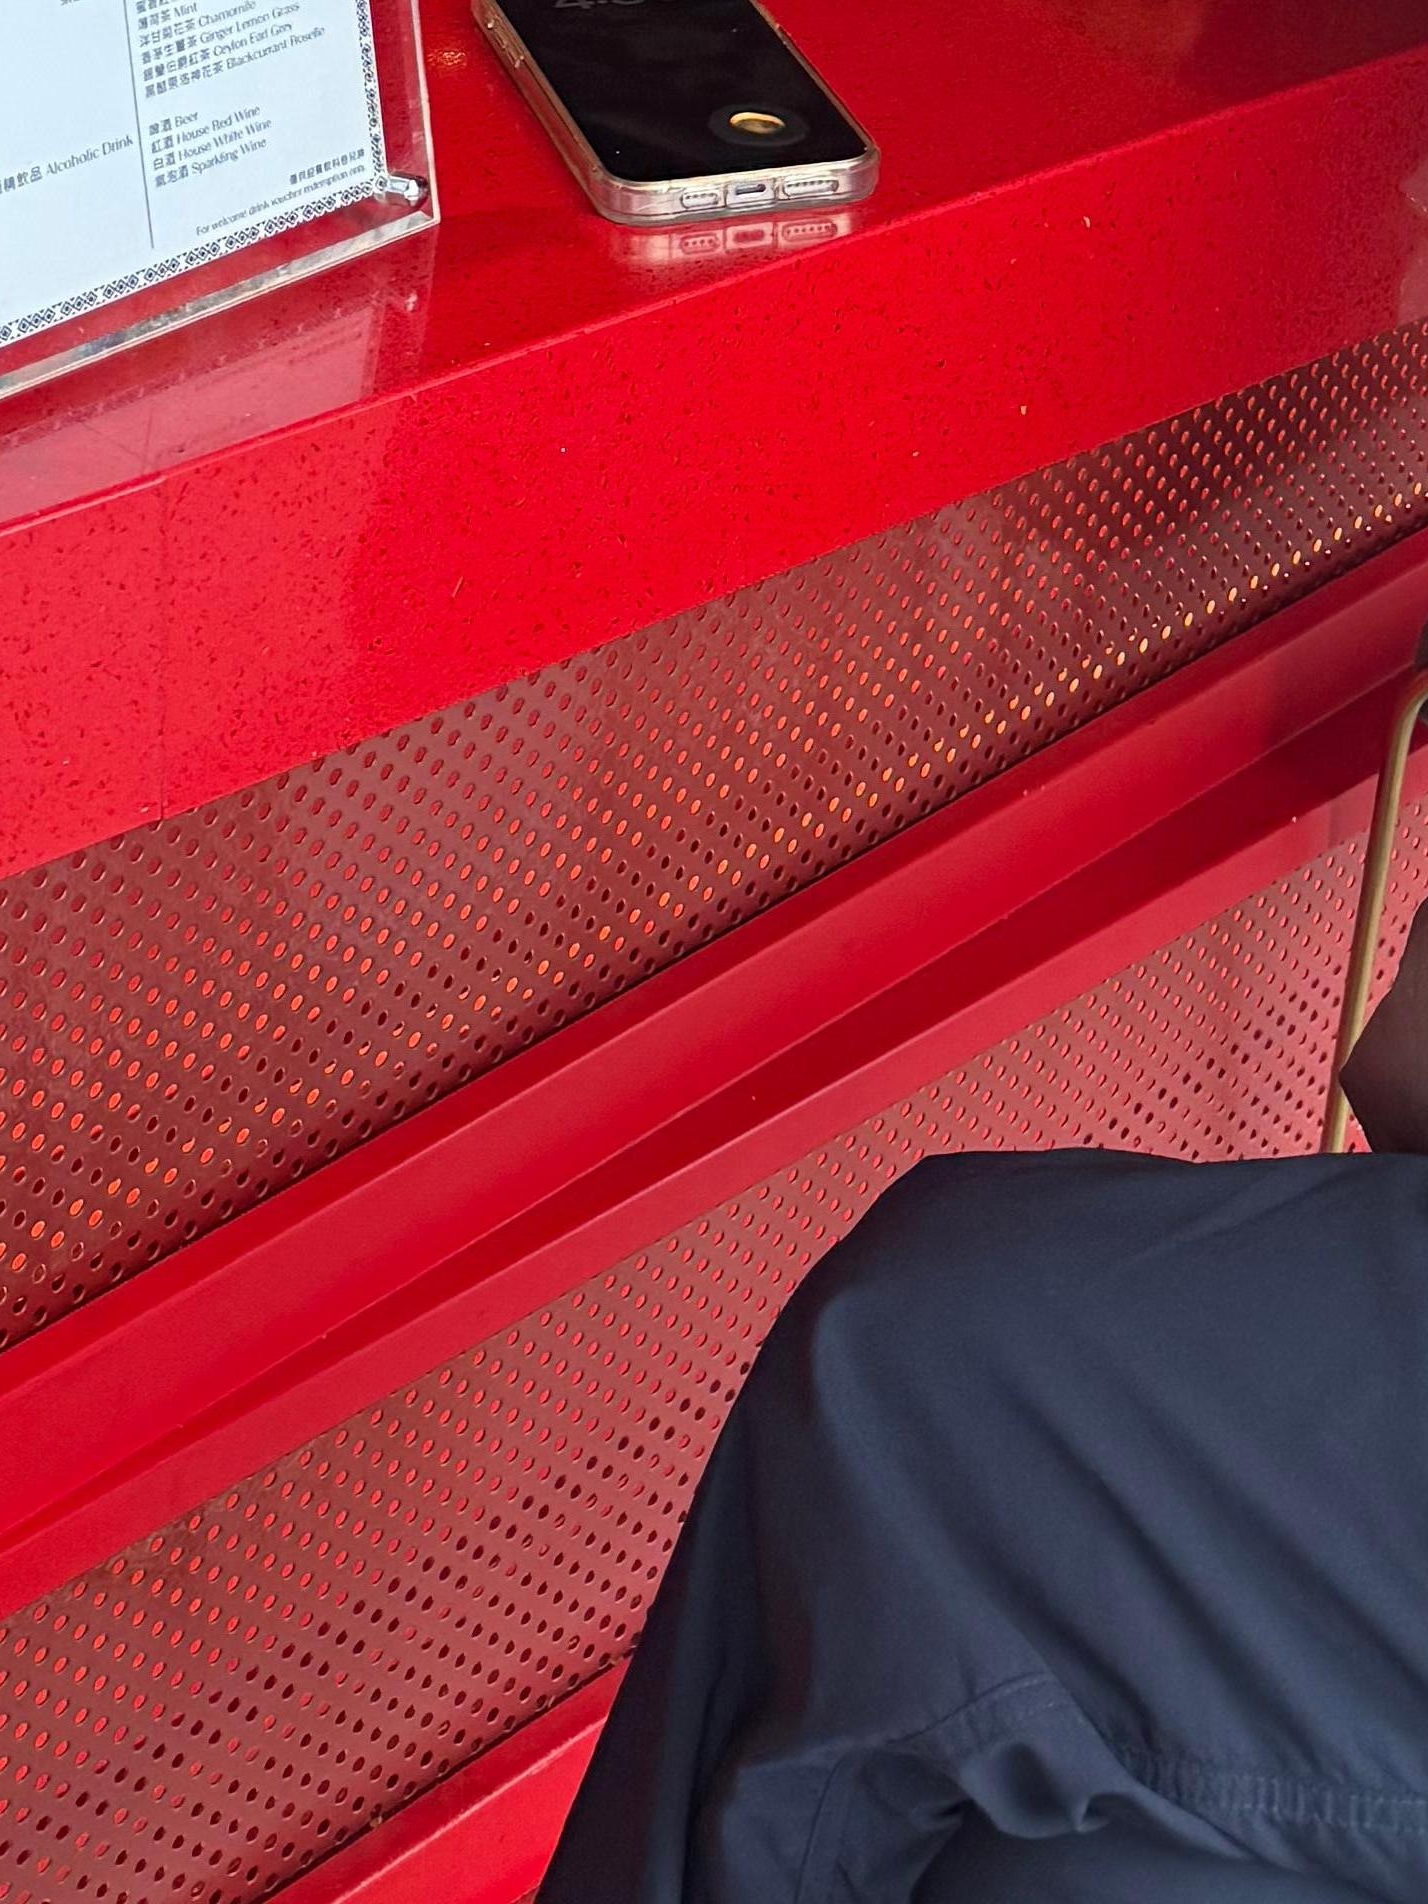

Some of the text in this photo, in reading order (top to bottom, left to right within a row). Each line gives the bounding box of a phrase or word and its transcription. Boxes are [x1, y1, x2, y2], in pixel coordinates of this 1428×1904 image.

[173, 2, 199, 19] Mint
[198, 0, 257, 28] Chamomile
[200, 26, 235, 45] Ginger
[235, 13, 271, 33] Lemon
[213, 38, 248, 58] Ceylon
[249, 28, 269, 44] Earl
[174, 111, 200, 129] Beer
[176, 125, 211, 145] House
[212, 116, 233, 133] Red
[233, 105, 261, 123] Wine
[46, 146, 101, 177] Alcoholic
[102, 134, 134, 157] Drink
[178, 142, 213, 162] House
[213, 129, 244, 149] White
[245, 118, 272, 137] Wine
[191, 148, 240, 176] Sparkling
[239, 138, 267, 156] Wine
[196, 225, 211, 237] For
